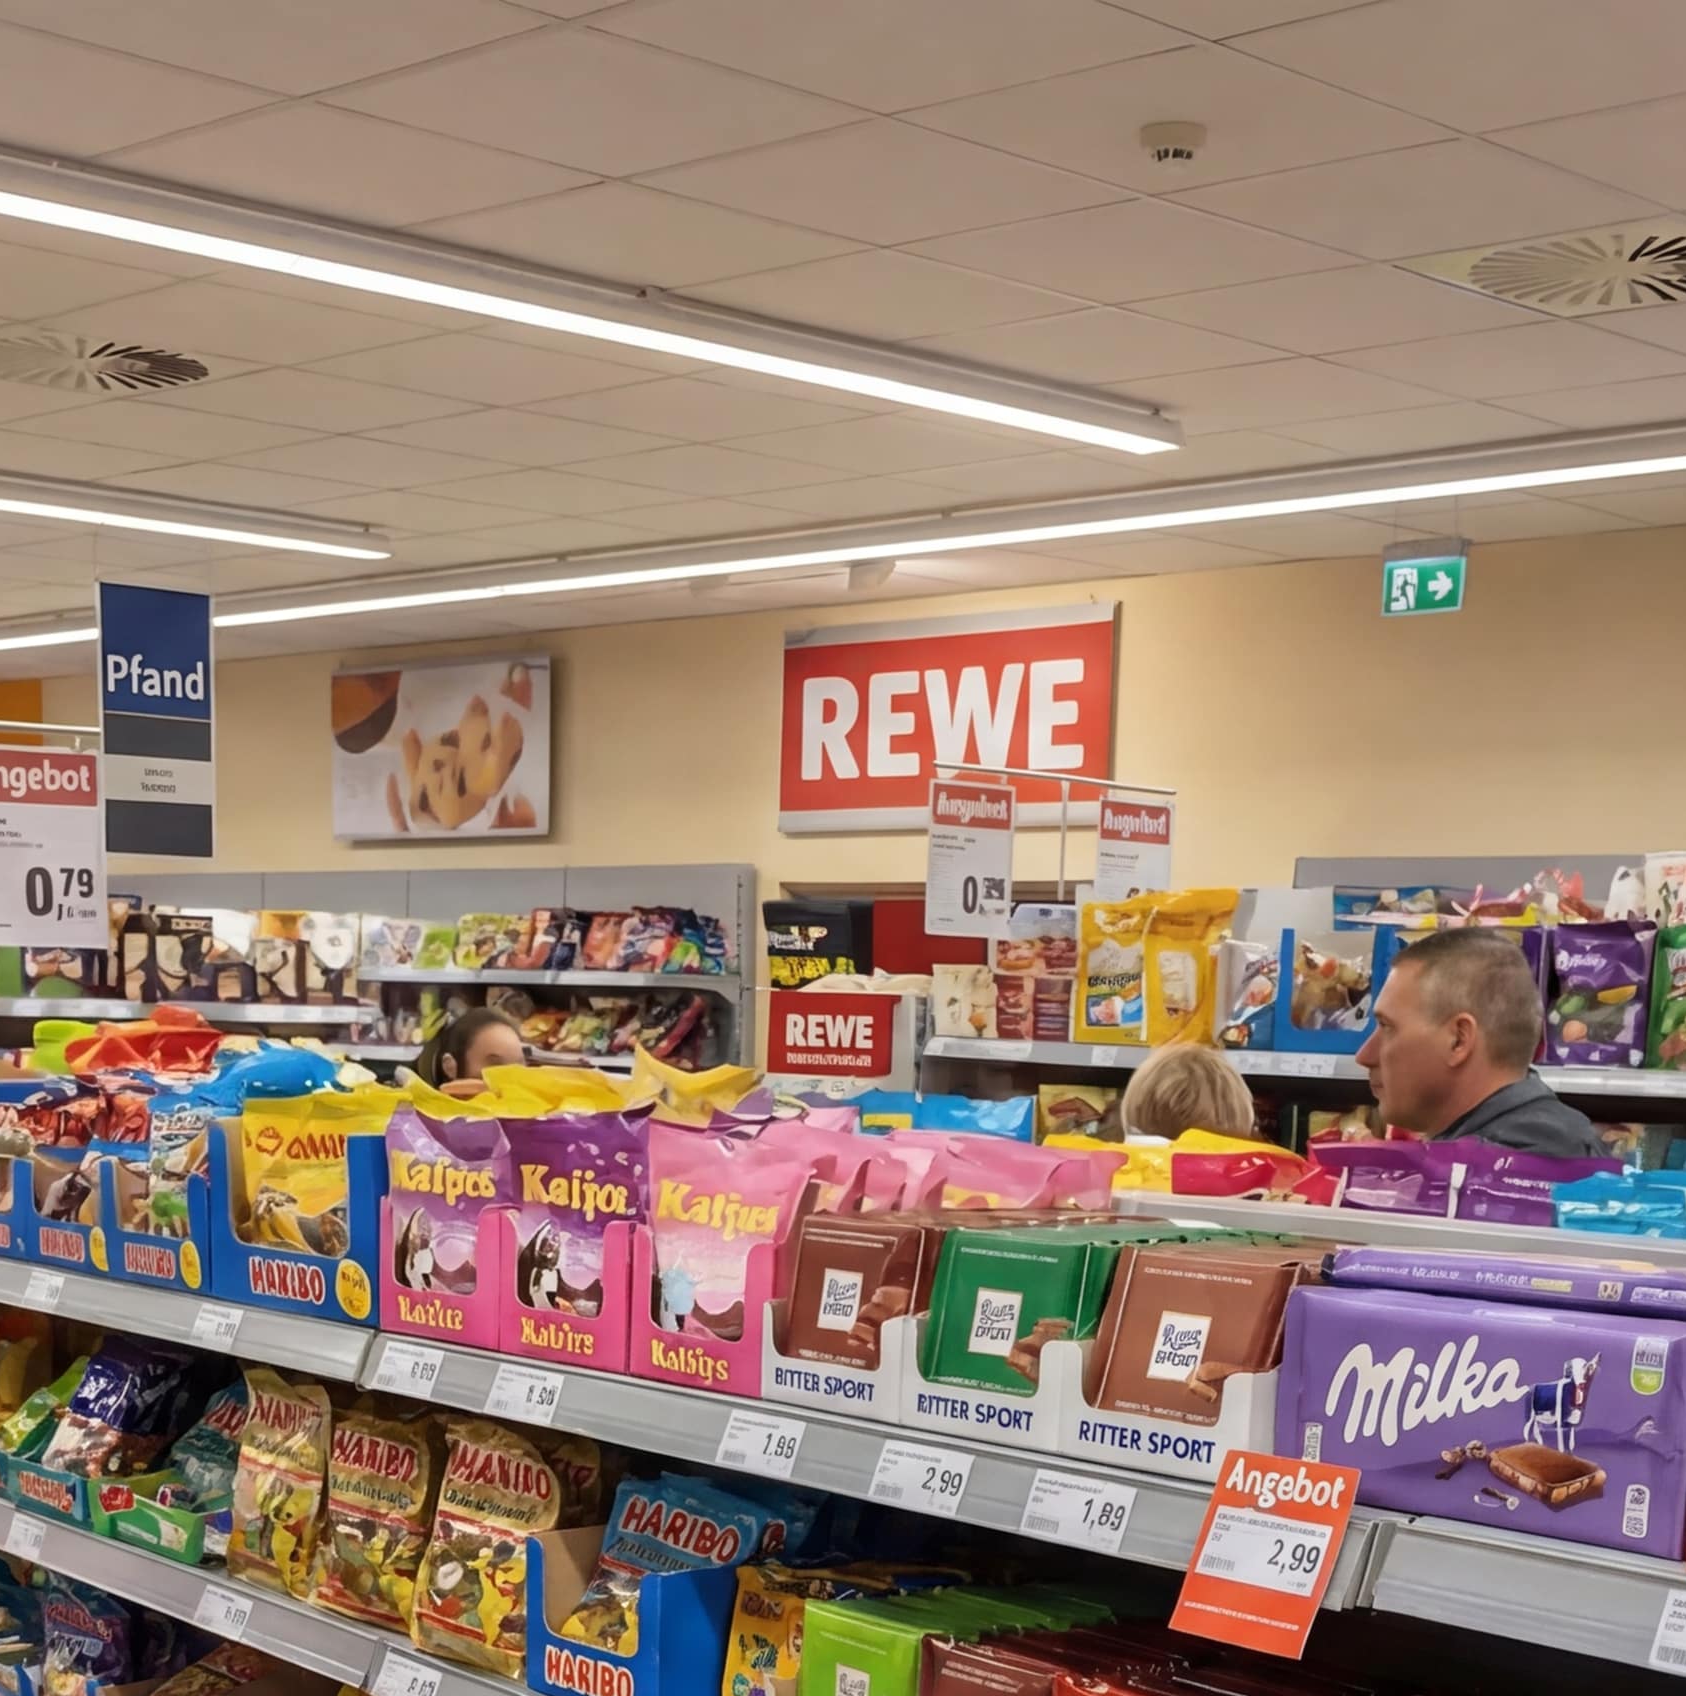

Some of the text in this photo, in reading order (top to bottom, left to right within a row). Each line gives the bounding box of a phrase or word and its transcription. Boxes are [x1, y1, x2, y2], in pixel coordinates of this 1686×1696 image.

[106, 652, 205, 702] Pfand
[801, 659, 1085, 780] REWE
[786, 1013, 873, 1049] REWE
[824, 1376, 875, 1403] SPORT
[1325, 1334, 1533, 1448] Milka
[975, 1405, 1034, 1433] SPORT
[1078, 1421, 1216, 1465] RITTER SPORT
[1225, 1454, 1346, 1513] Angebot
[620, 1497, 742, 1568] HARIBO
[1266, 1537, 1323, 1575] 2,99
